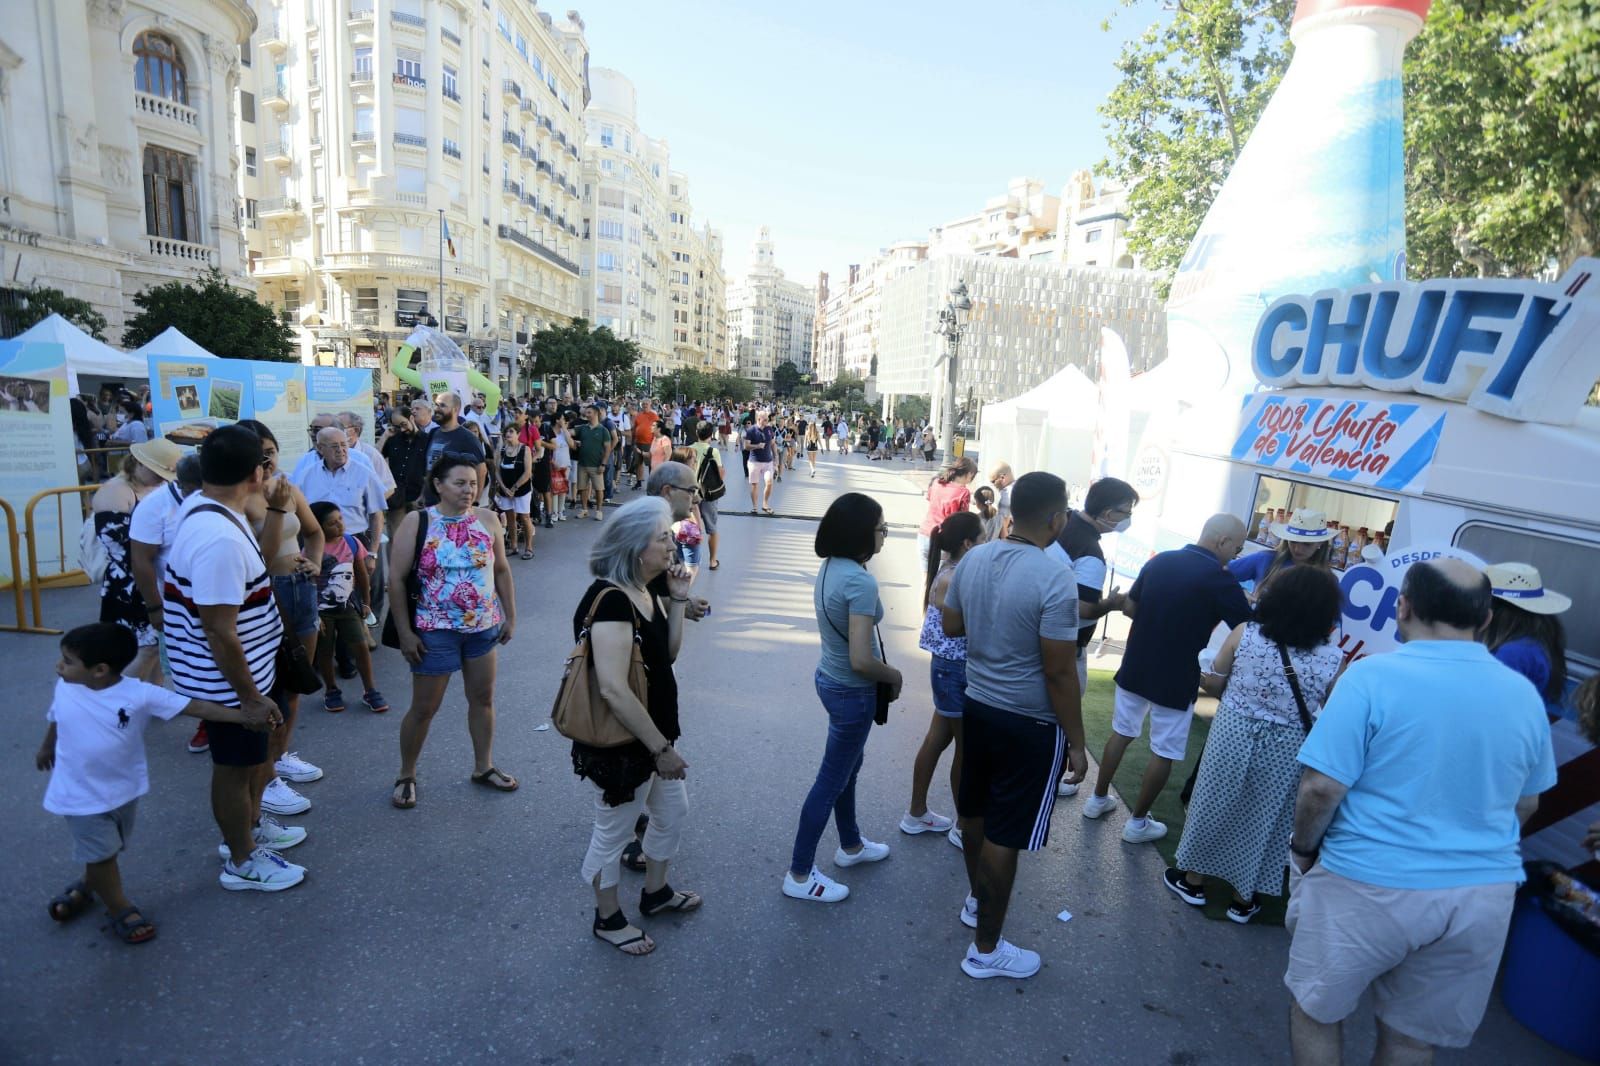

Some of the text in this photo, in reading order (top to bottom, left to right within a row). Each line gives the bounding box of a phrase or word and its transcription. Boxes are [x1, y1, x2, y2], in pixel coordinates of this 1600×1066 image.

[1258, 403, 1397, 447] 100% Chufa
[1254, 429, 1390, 475] de Valencia
[1391, 551, 1442, 569] DESDE
